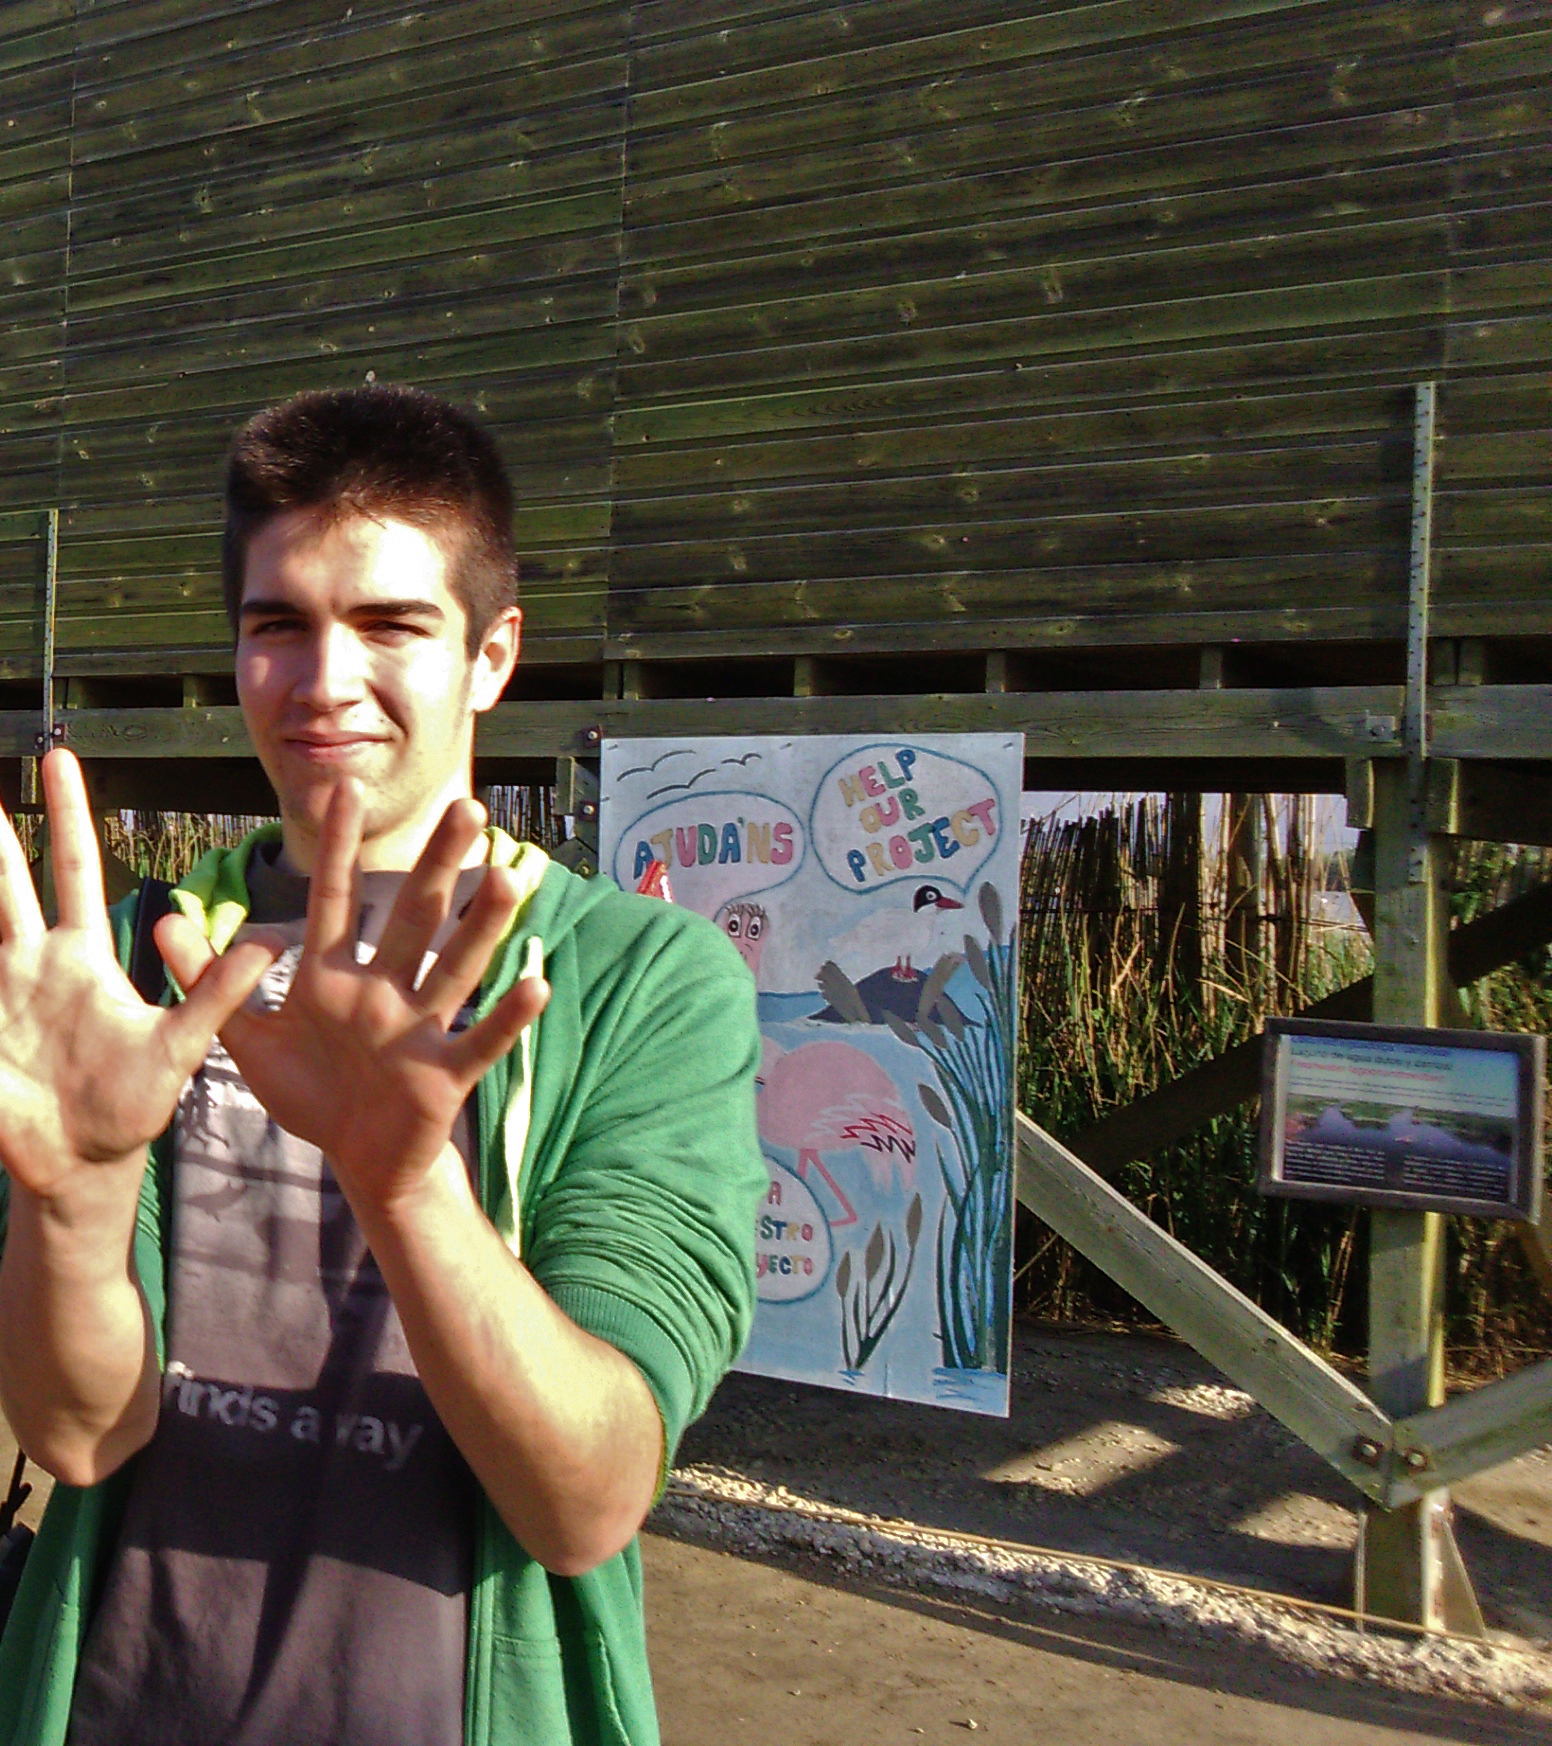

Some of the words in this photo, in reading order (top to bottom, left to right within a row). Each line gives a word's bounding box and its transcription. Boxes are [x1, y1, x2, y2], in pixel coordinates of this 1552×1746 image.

[838, 749, 916, 807] HELP
[859, 788, 925, 834] OUR
[847, 798, 997, 883] PROJECT
[755, 1214, 814, 1242] STRO
[290, 1405, 321, 1443] a
